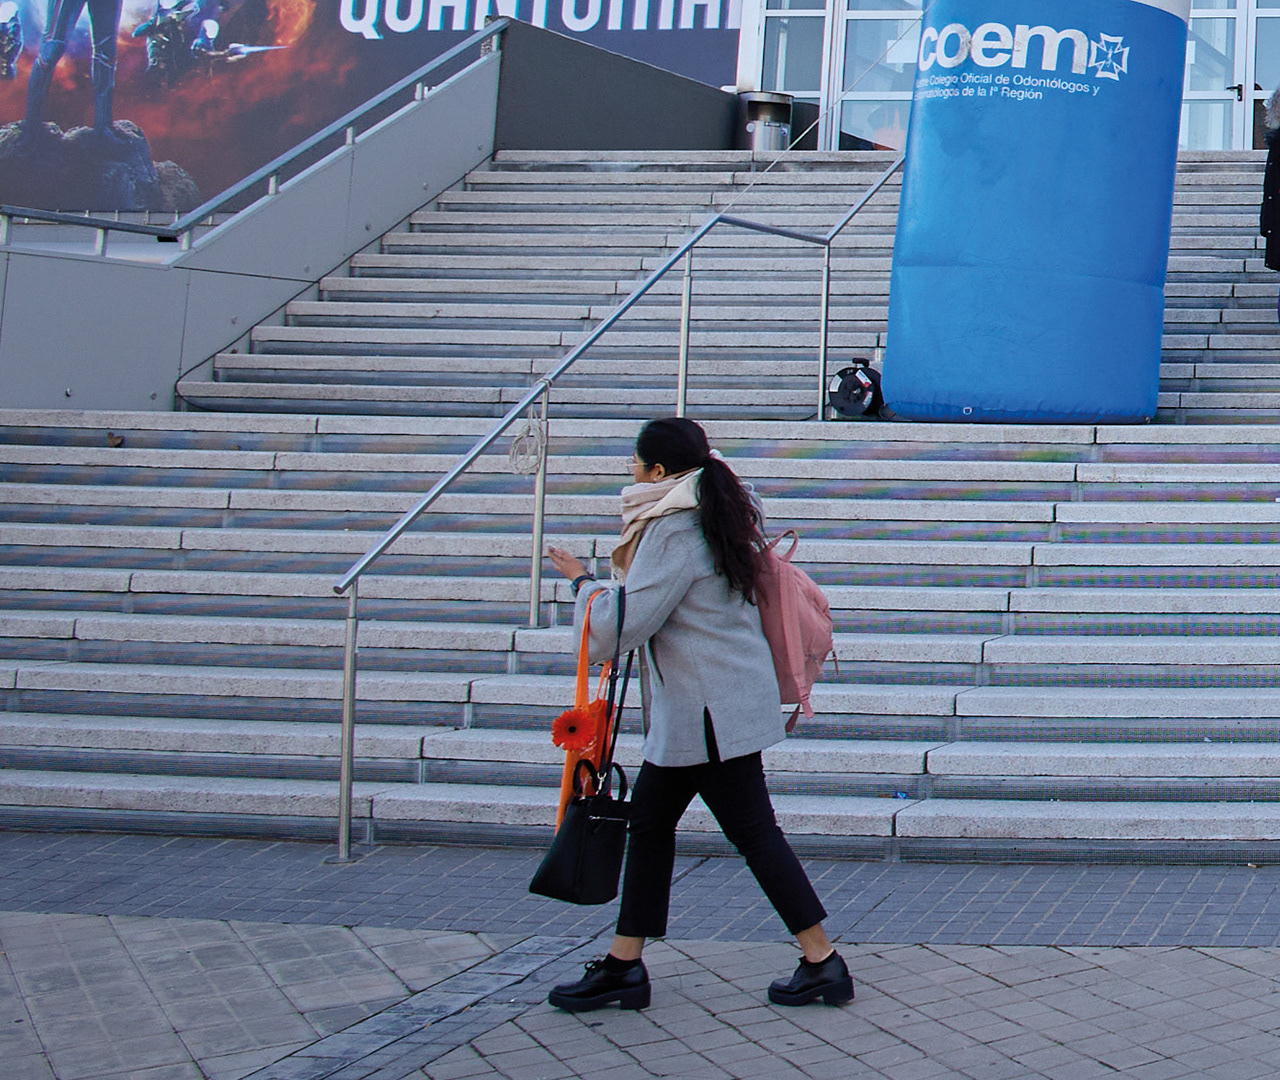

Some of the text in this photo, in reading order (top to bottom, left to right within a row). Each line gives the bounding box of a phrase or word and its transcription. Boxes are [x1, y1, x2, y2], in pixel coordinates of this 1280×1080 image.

[918, 21, 1090, 75] coem
[929, 74, 958, 87] Colegio
[960, 72, 992, 84] Oficial
[995, 74, 1010, 85] de
[1012, 74, 1090, 93] Odontólogos
[1092, 86, 1100, 96] y
[961, 86, 975, 97] de
[977, 86, 986, 96] la
[1001, 86, 1043, 101] Región
